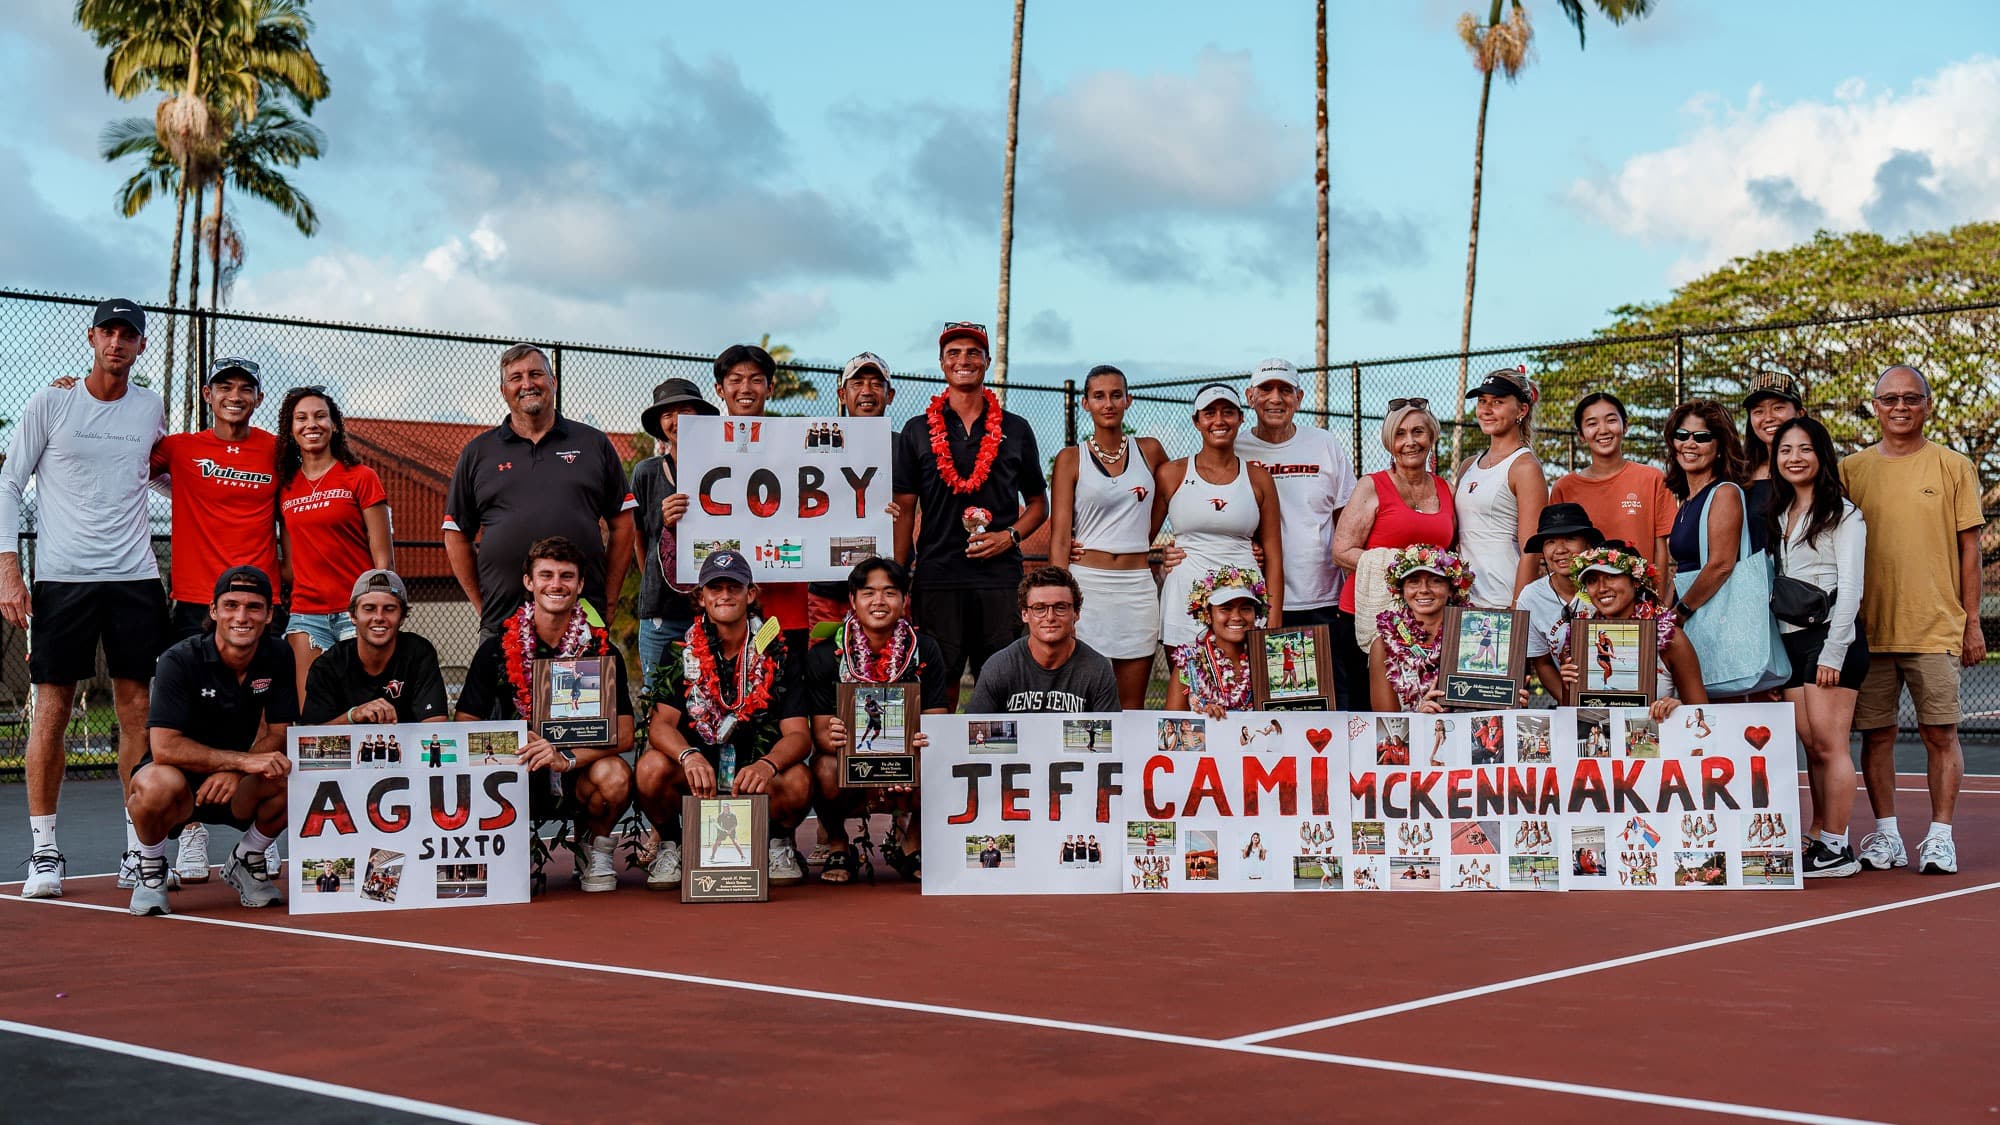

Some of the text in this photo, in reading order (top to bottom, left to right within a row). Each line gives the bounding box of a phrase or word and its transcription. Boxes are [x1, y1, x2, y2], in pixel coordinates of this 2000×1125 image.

[192, 458, 272, 484] Vulcans
[216, 479, 260, 489] TENNIS
[699, 465, 878, 518] COBY
[292, 500, 330, 513] TENNIS
[1007, 690, 1087, 713] MEN'S TENNI
[299, 770, 519, 838] AGUS
[947, 761, 1123, 825] JEFF
[1142, 754, 1330, 820] CAMI
[1349, 766, 1561, 820] MCKENNA
[1567, 755, 1770, 814] AKARI
[418, 833, 506, 861] SIXTO
